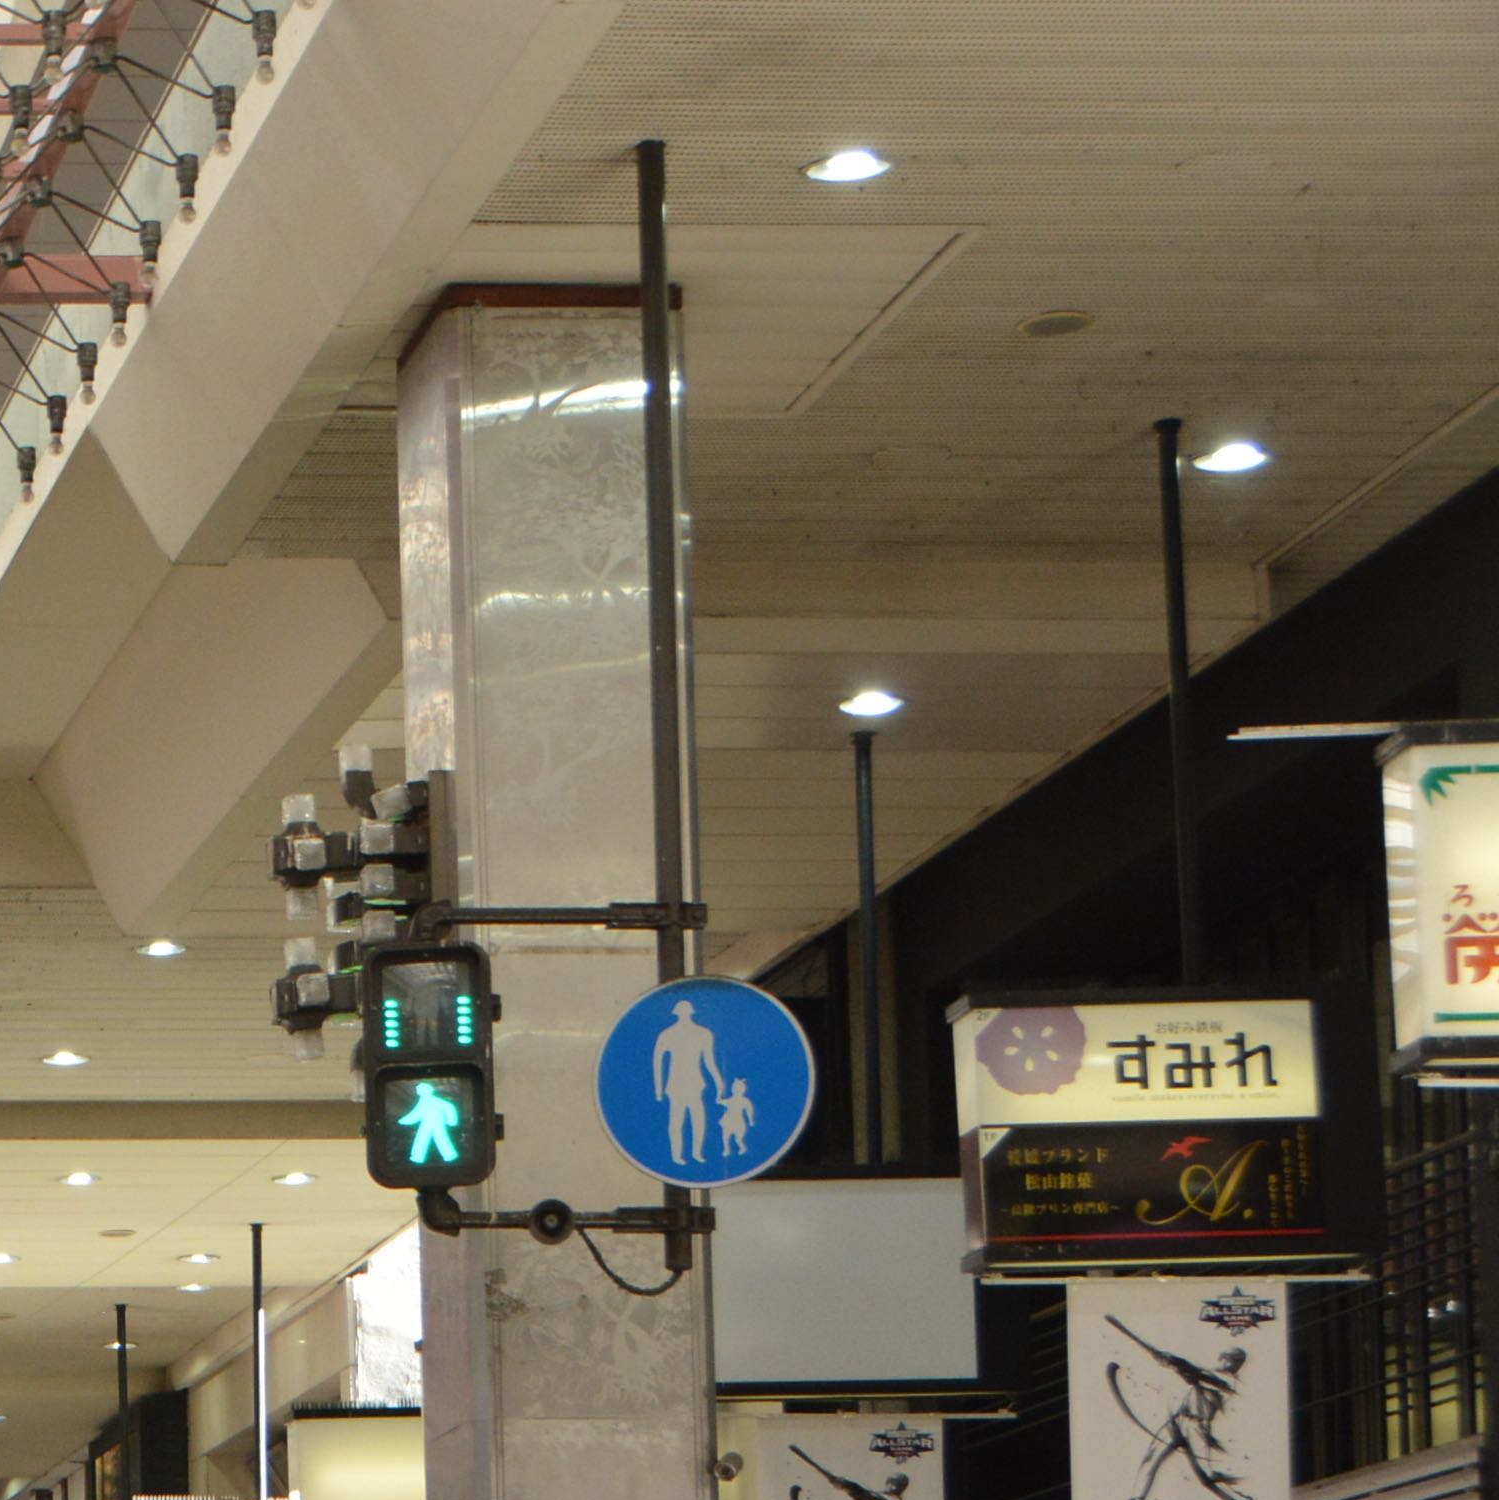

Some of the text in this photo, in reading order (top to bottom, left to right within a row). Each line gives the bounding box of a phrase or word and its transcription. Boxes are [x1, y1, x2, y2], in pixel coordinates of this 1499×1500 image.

[1155, 1020, 1224, 1034] お好み鉄板
[1106, 1032, 1279, 1089] すみれ
[1006, 1147, 1109, 1167] 愛媛ブランド
[1025, 1172, 1094, 1192] 松山銘菓
